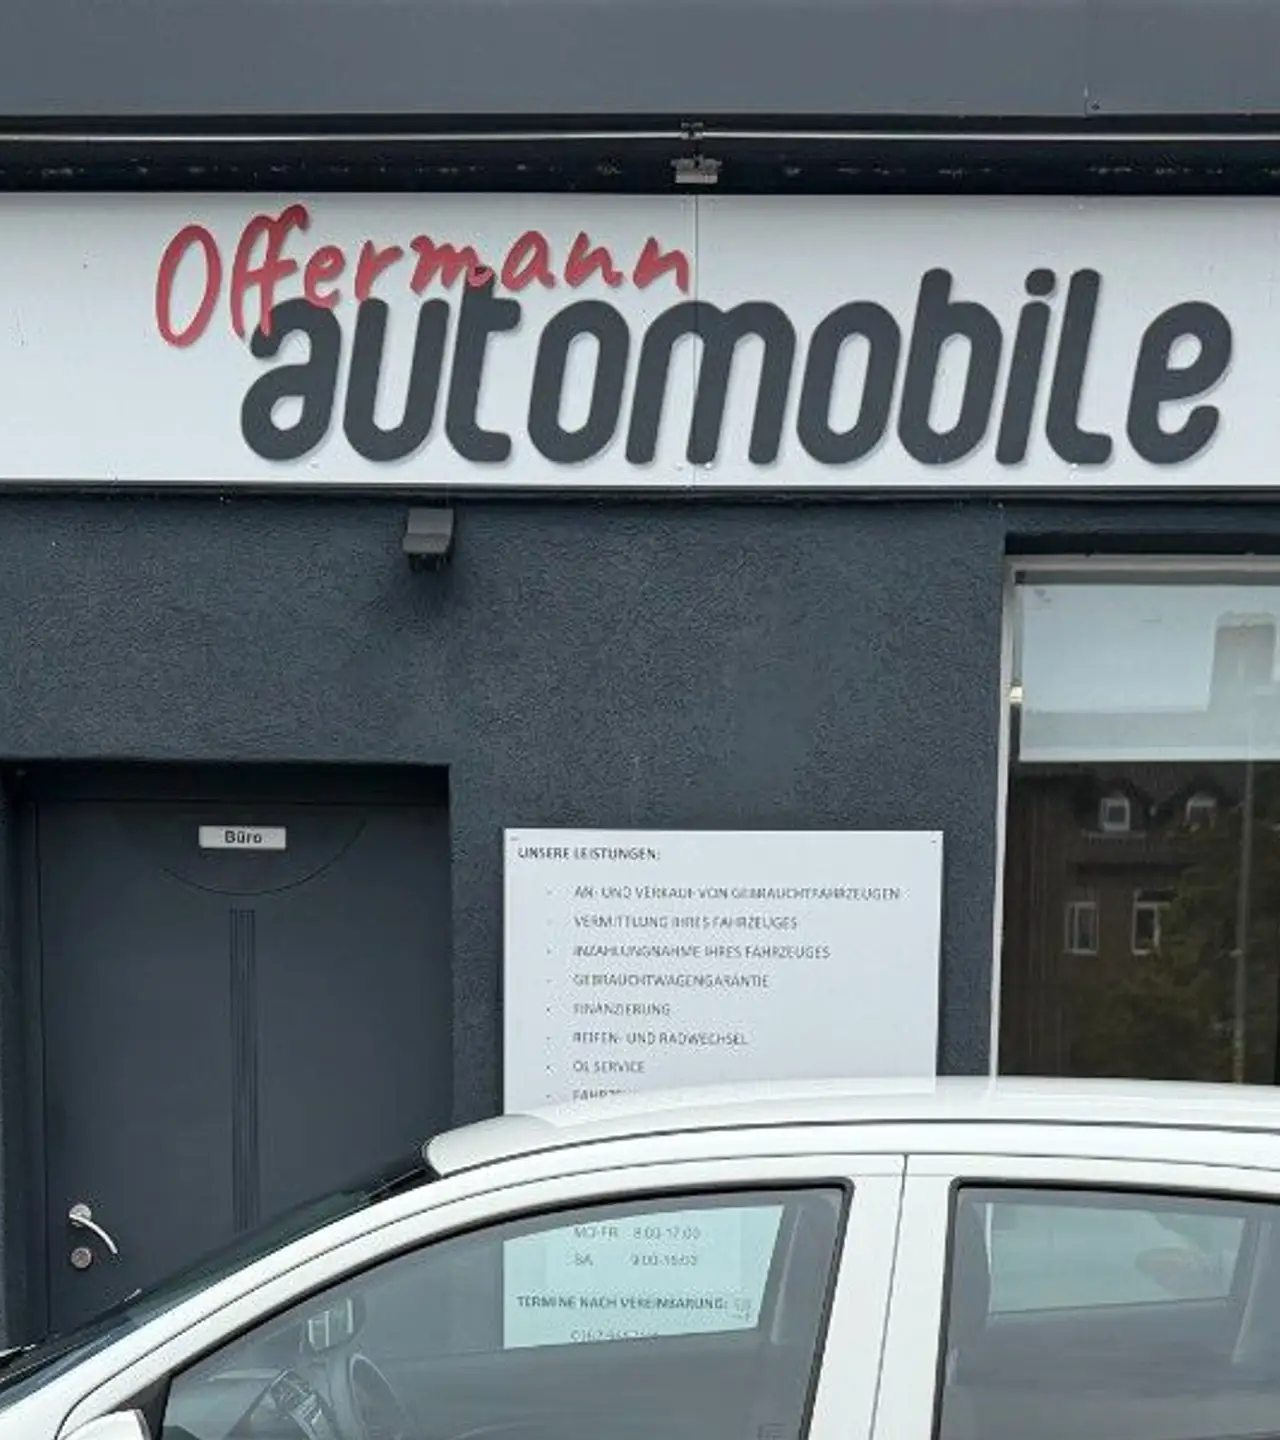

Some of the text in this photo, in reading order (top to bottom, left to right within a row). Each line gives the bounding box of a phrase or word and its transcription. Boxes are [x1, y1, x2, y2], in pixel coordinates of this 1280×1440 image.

[154, 202, 691, 347] Offermann
[240, 267, 1233, 468] automobile
[224, 830, 263, 844] Büro
[518, 846, 661, 862] UNSERE LEISTUNGEN:
[601, 885, 632, 899] UND
[635, 886, 694, 900] VERKAUF
[697, 887, 728, 900] VON
[574, 915, 668, 929] VERMITTLUNG
[712, 916, 798, 930] FAHRZEUGES
[705, 945, 742, 959] IHRES
[745, 945, 832, 960] FAHRZEUGES
[572, 974, 770, 989] GEBRAUCHTWAGENGARANTIE
[573, 1003, 671, 1017] FINANZIERUNG
[626, 1031, 656, 1046] UND
[659, 1032, 748, 1047] RADWECHSEL
[594, 1060, 646, 1074] SERVICE
[516, 1295, 577, 1309] TERMINE
[580, 1295, 617, 1310] NACH
